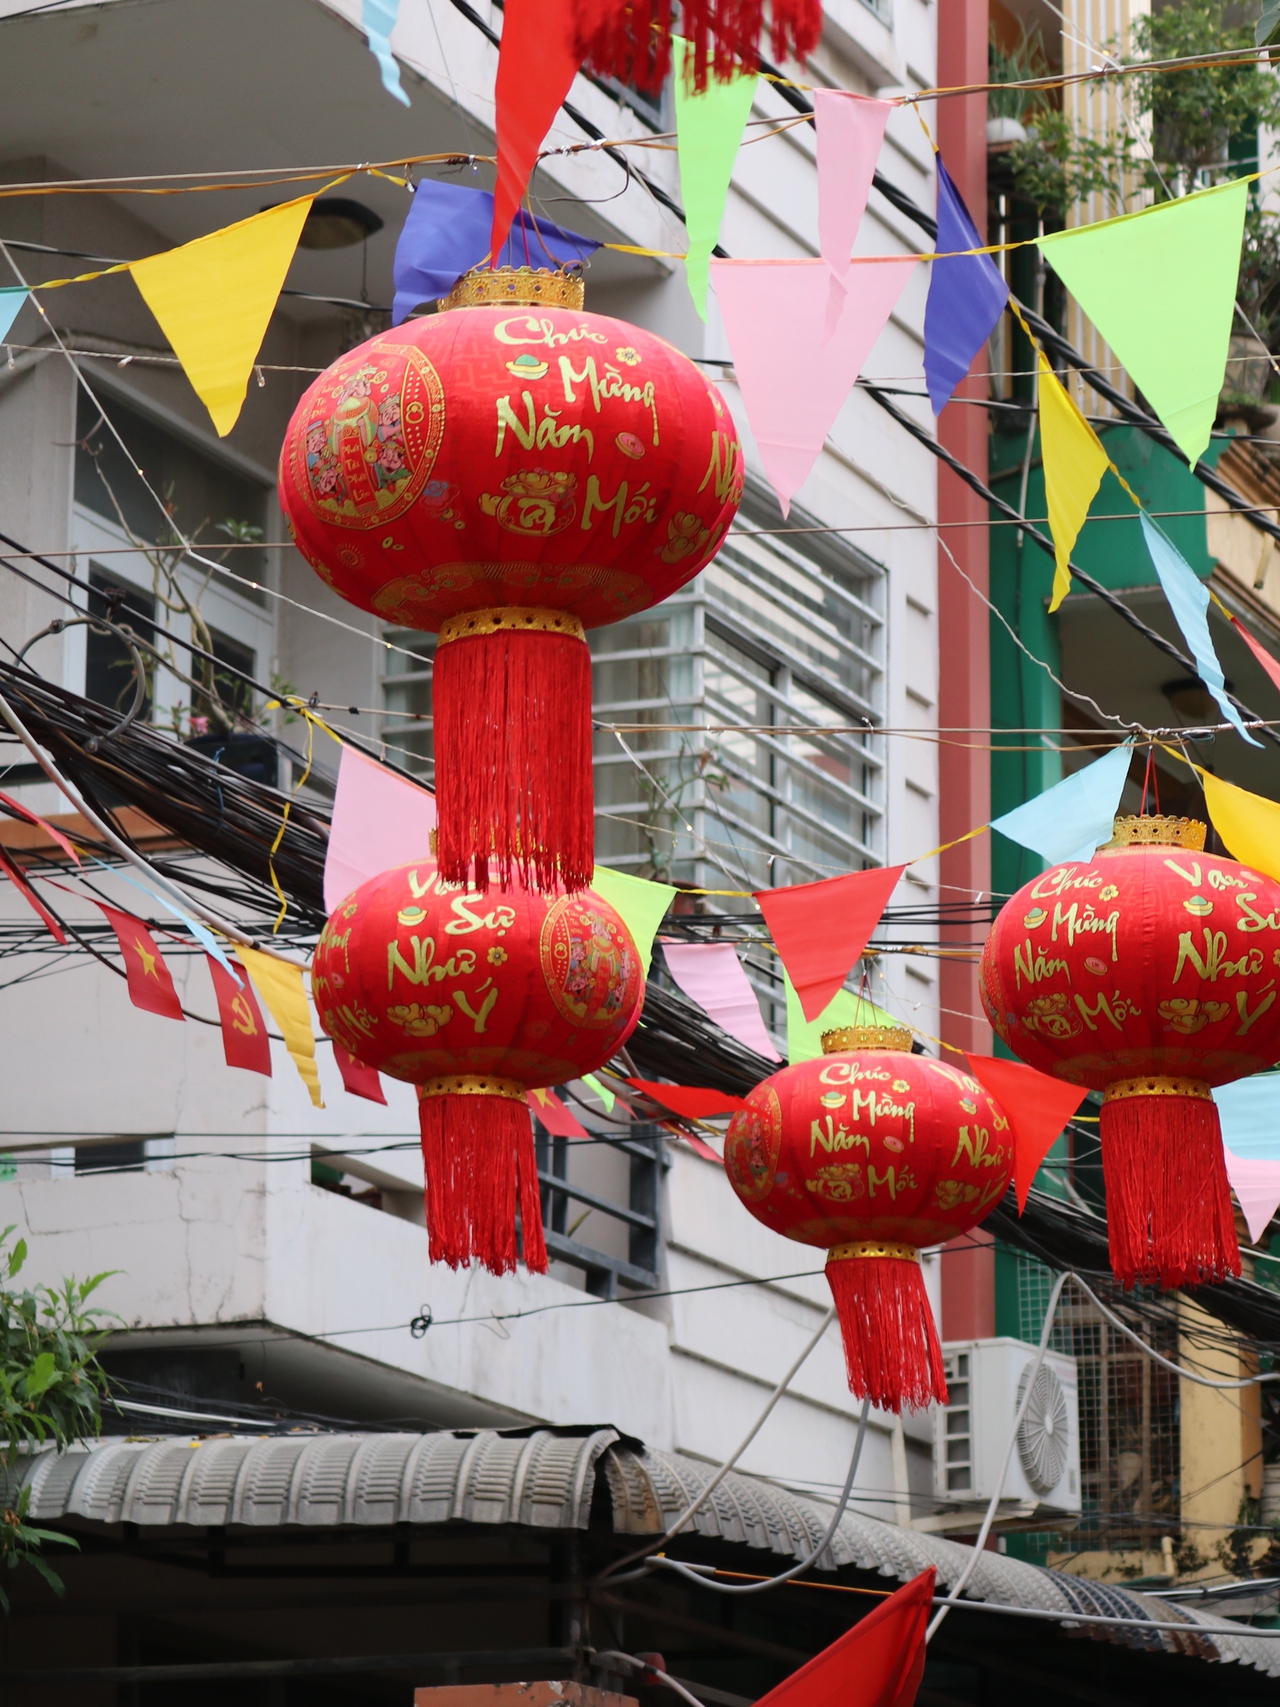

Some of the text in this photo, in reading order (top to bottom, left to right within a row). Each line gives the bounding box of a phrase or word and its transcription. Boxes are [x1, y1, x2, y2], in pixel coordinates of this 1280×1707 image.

[494, 315, 608, 347] Chúc
[494, 390, 595, 464] Năm
[558, 355, 660, 447] Mừng
[580, 474, 658, 539] Mới
[1031, 867, 1104, 899] Chúc
[1164, 859, 1249, 890] Vạn
[444, 893, 517, 937] Sự
[1052, 902, 1120, 962] Mừng
[387, 935, 477, 992] Như
[1014, 939, 1072, 991] Năm
[1172, 927, 1265, 985] Như
[452, 977, 499, 1033] Ý
[1074, 989, 1142, 1031] Mới
[1236, 979, 1277, 1036] Ý
[819, 1062, 892, 1085] Chúc
[810, 1115, 870, 1158] Năm
[853, 1088, 915, 1143] Mừng
[867, 1164, 919, 1201] Mới
